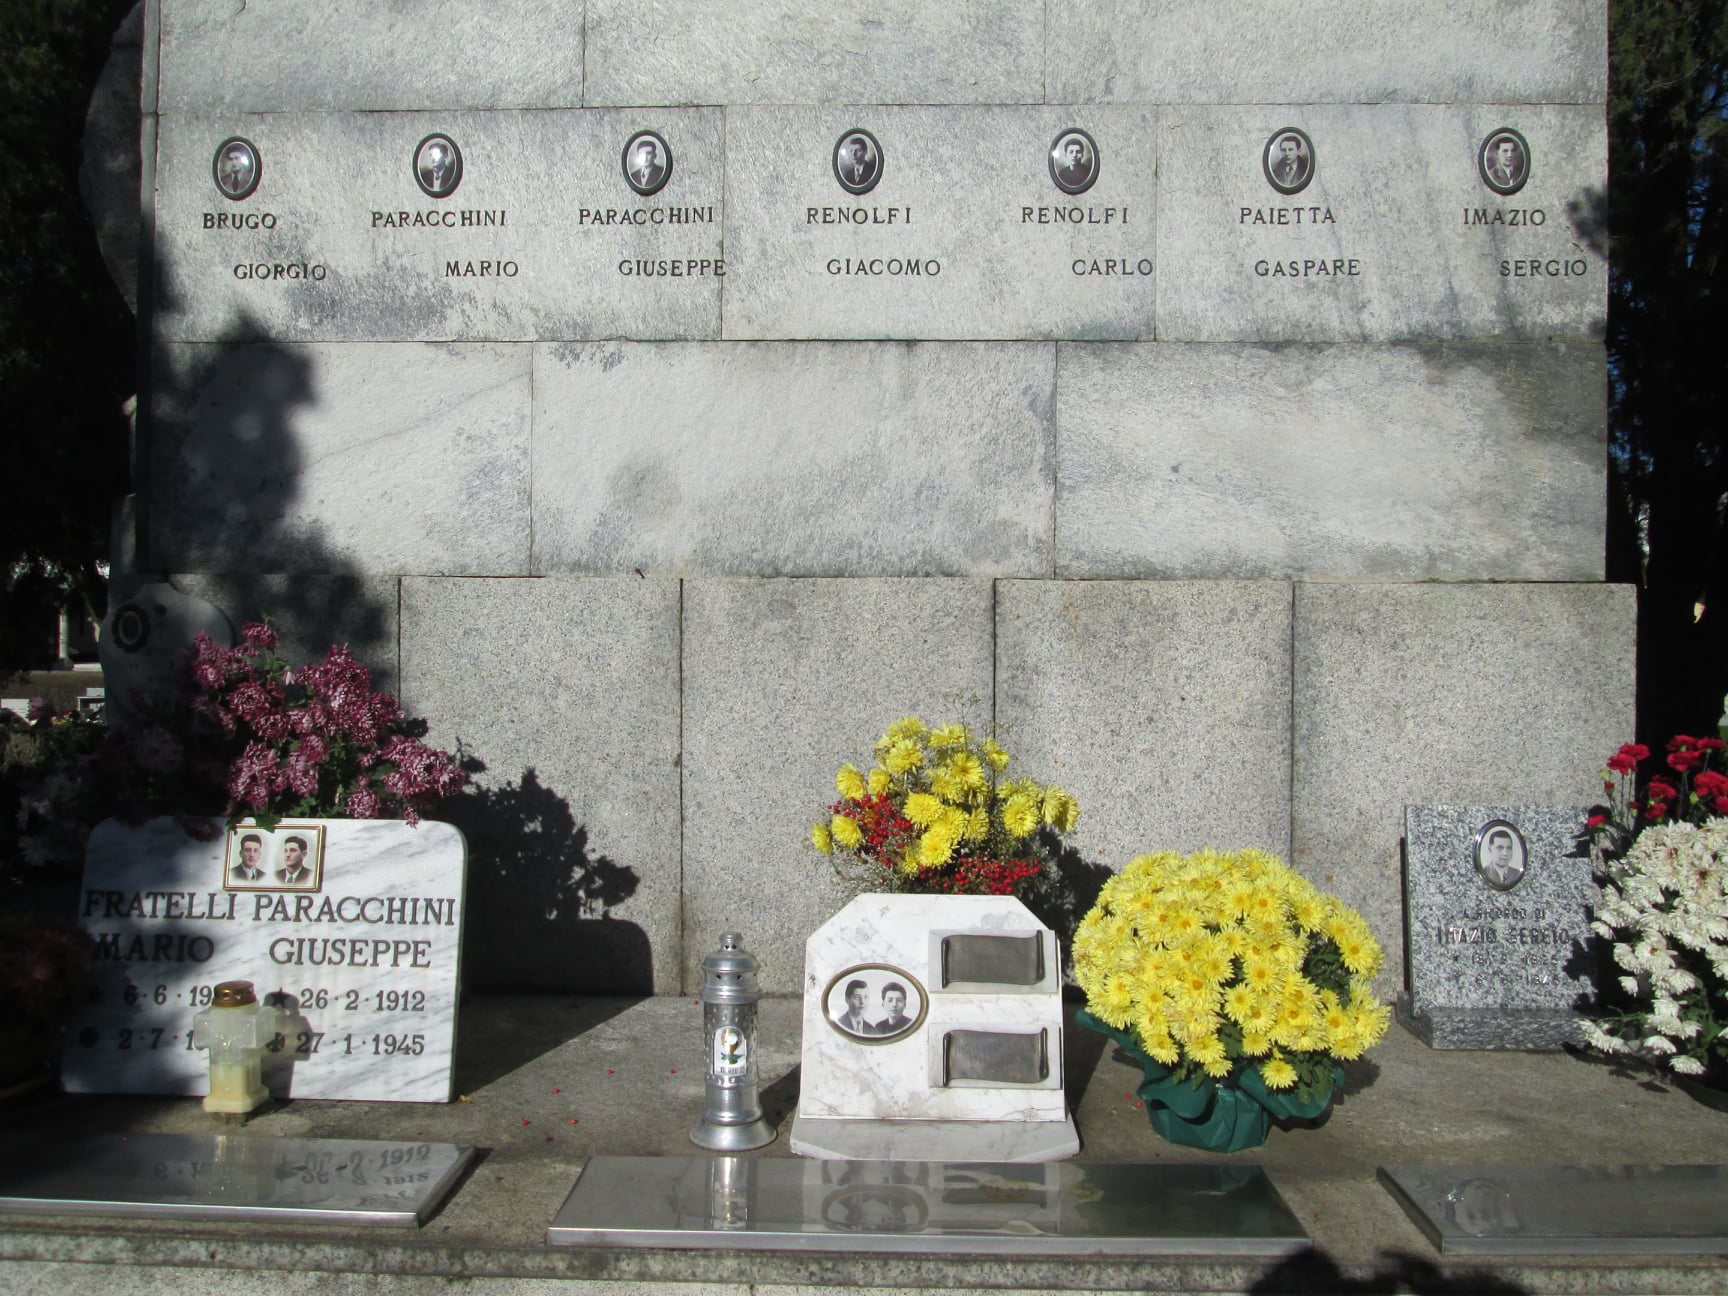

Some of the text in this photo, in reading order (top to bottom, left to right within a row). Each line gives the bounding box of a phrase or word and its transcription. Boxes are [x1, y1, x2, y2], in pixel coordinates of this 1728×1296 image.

[203, 212, 278, 230] BRUGO
[372, 209, 507, 228] PARACCHINI
[578, 207, 715, 226] PARACCHINI
[806, 207, 911, 225] RENOLFI
[1021, 206, 1128, 224] RENOLFI
[1239, 207, 1337, 225] PAIETTA
[1463, 207, 1546, 226] IMAZIO
[234, 263, 327, 281] GIORGIO
[445, 260, 519, 278] MARIO
[618, 258, 727, 277] GIUSEPPE
[826, 259, 941, 276] GIACOMO
[1071, 258, 1154, 276] CARLO
[1254, 258, 1361, 277] GASPARE
[1500, 258, 1588, 277] SERGIO
[83, 889, 456, 926] FRATELLI PARACCHINI
[93, 932, 432, 968] MARIO GIUSEPPE
